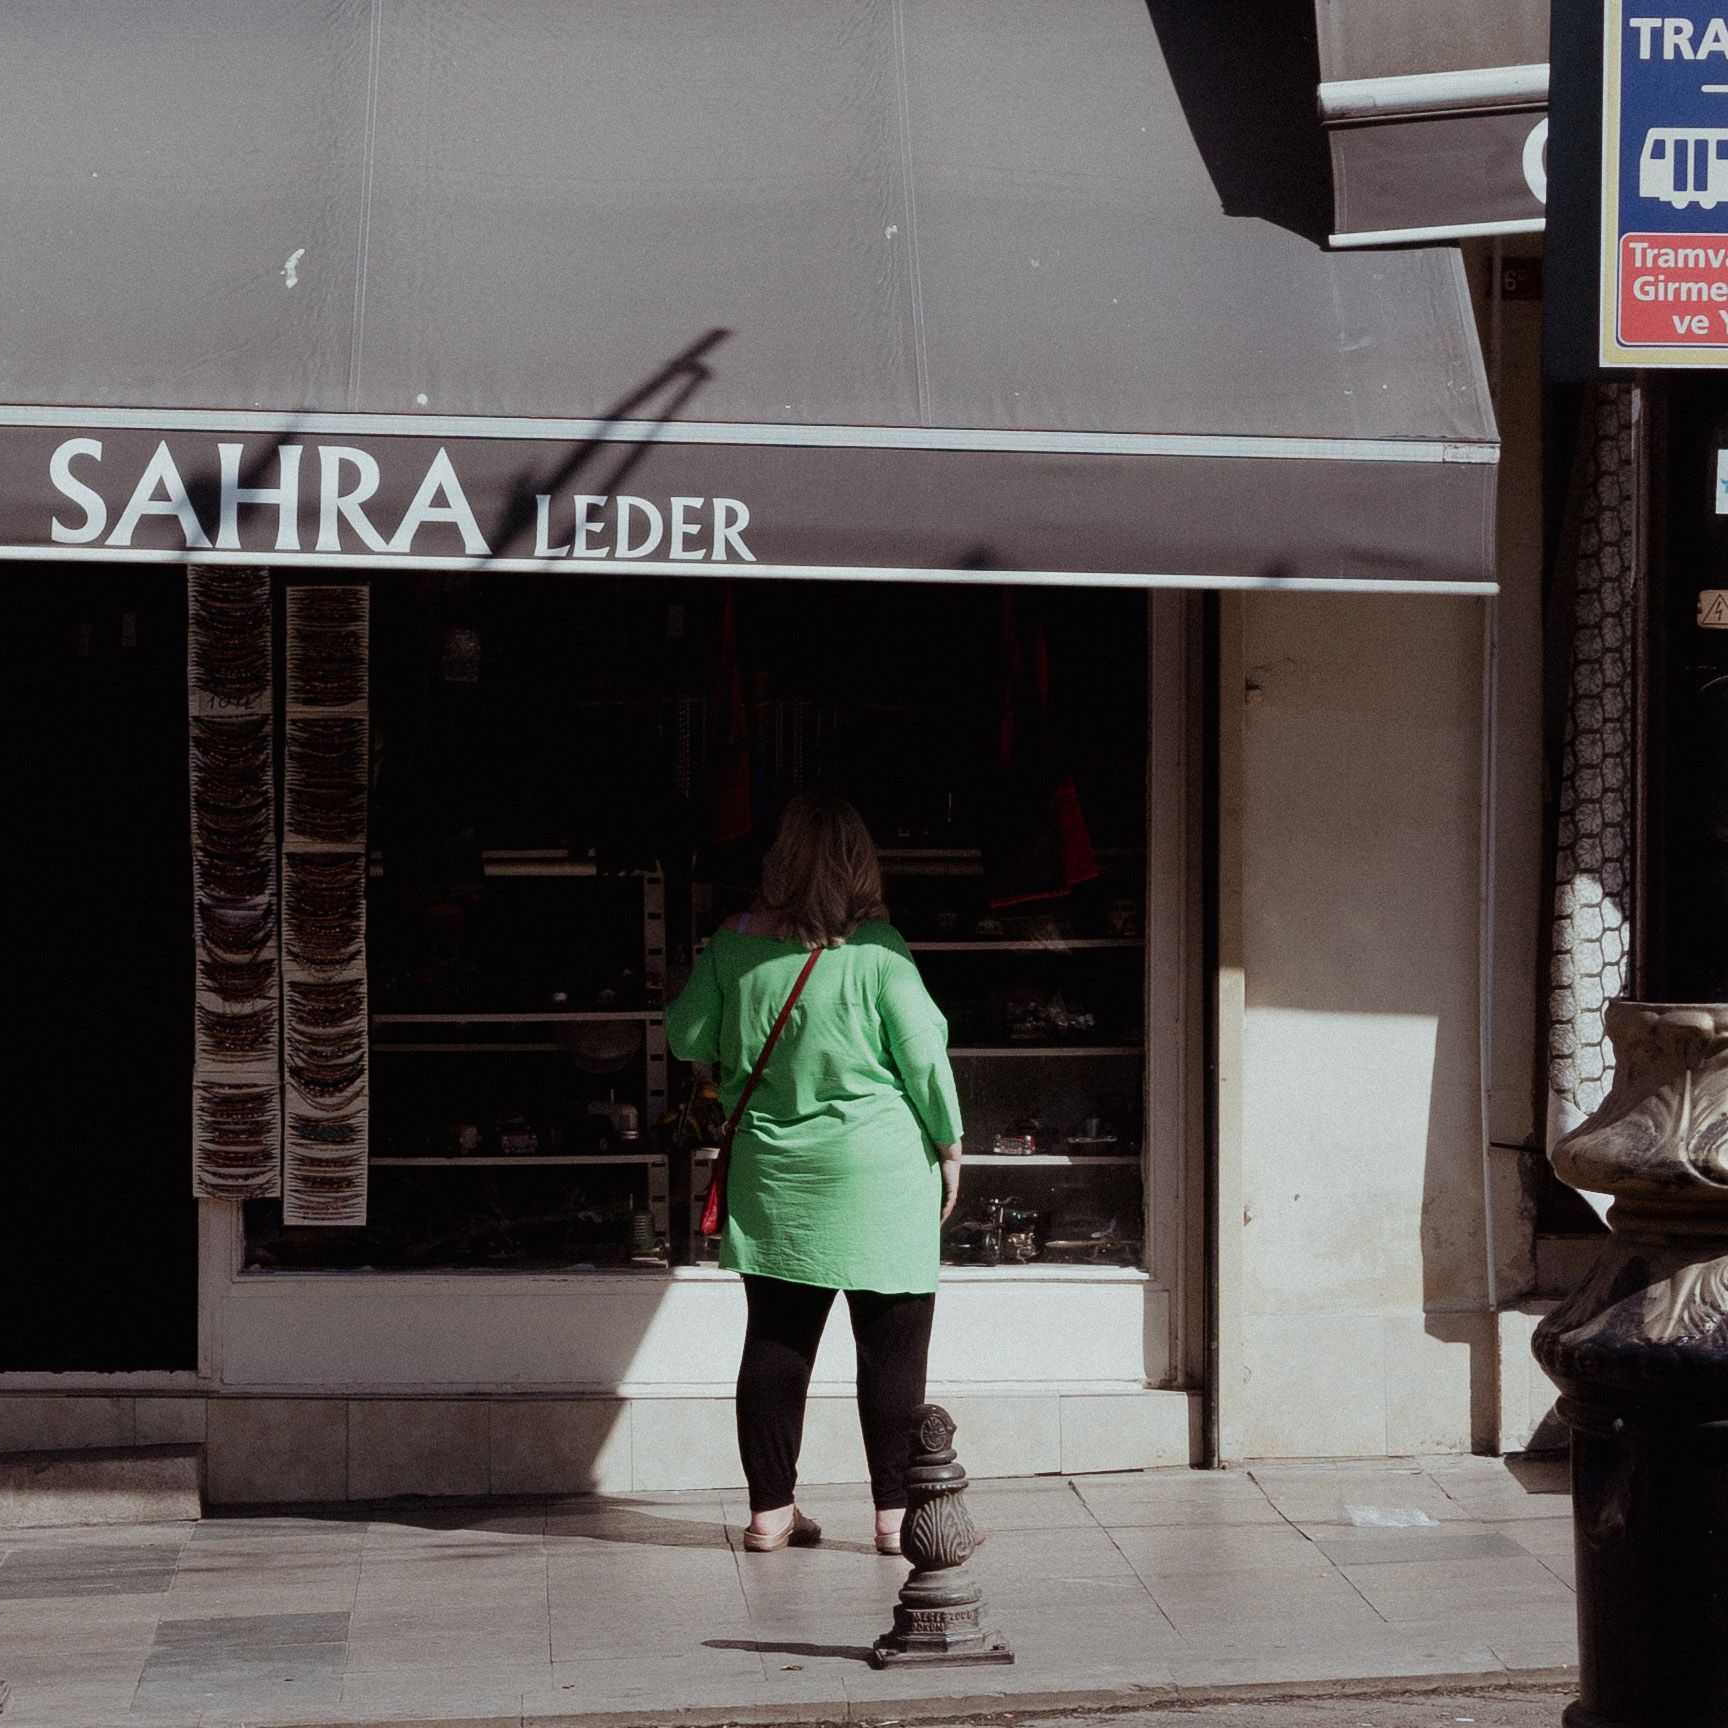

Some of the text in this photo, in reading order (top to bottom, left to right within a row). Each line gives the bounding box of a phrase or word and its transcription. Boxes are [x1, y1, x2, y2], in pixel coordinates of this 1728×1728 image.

[1629, 18, 1728, 60] TRA
[1629, 242, 1728, 268] Tramv
[1633, 275, 1728, 302] Girme
[1672, 314, 1709, 335] ve
[48, 437, 757, 563] SAHRA LEDER
